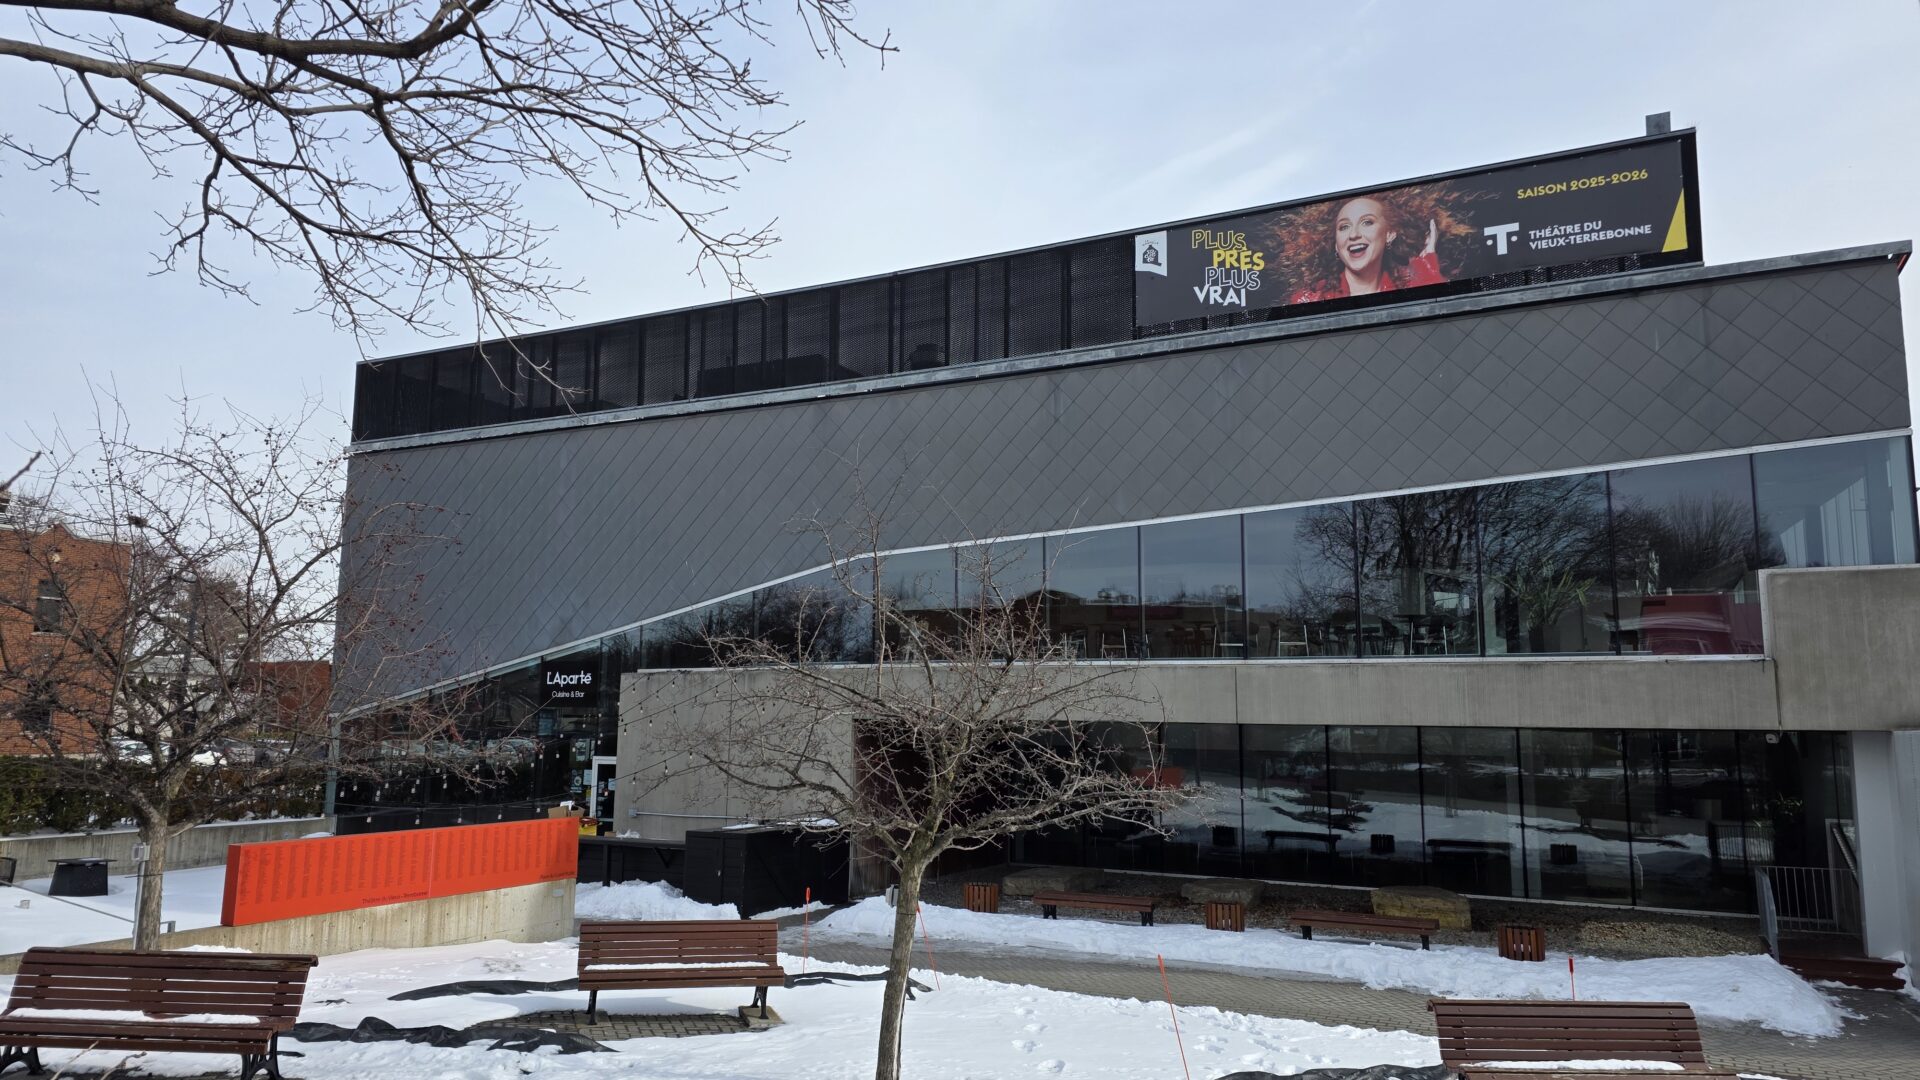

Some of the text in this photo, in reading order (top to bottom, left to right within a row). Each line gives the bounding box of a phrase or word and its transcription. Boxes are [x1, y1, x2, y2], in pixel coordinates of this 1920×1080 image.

[1517, 169, 1649, 199] SAISON 2025-2026
[1192, 229, 1246, 252] PLUS
[1529, 220, 1602, 240] THÉÂTRE DU
[1529, 224, 1652, 250] VIEUX-TERREBONNE
[1206, 266, 1261, 291] PLUS
[1193, 284, 1246, 307] VRAI
[552, 690, 585, 698] Cuisine & Bar
